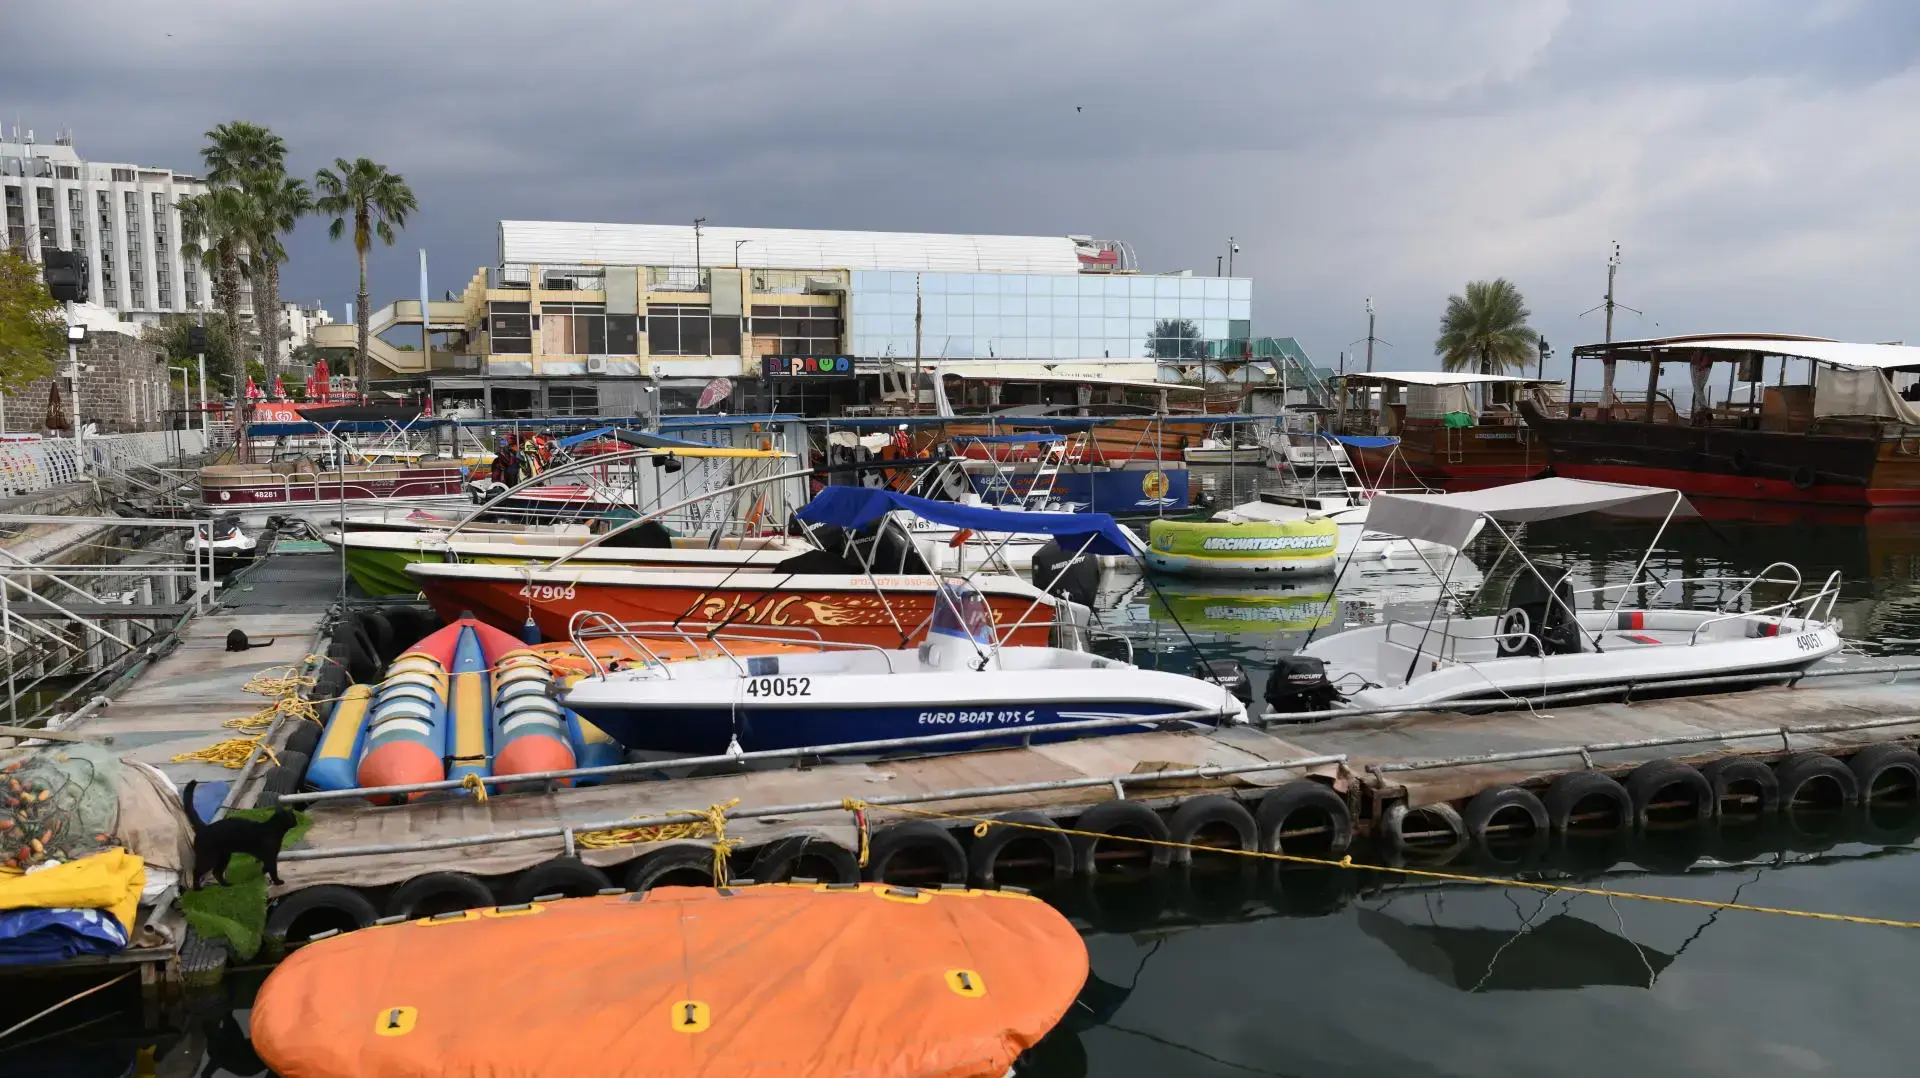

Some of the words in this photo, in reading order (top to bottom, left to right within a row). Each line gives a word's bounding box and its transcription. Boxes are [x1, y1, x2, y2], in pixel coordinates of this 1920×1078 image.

[769, 357, 849, 376] משחקיה
[1051, 556, 1086, 570] MERURY
[519, 585, 576, 600] 47909
[1796, 633, 1824, 651] 49051
[746, 677, 812, 697] 49052
[918, 712, 956, 724] EURO
[959, 711, 994, 724] BOAT
[998, 711, 1021, 724] 475
[1025, 710, 1035, 722] C
